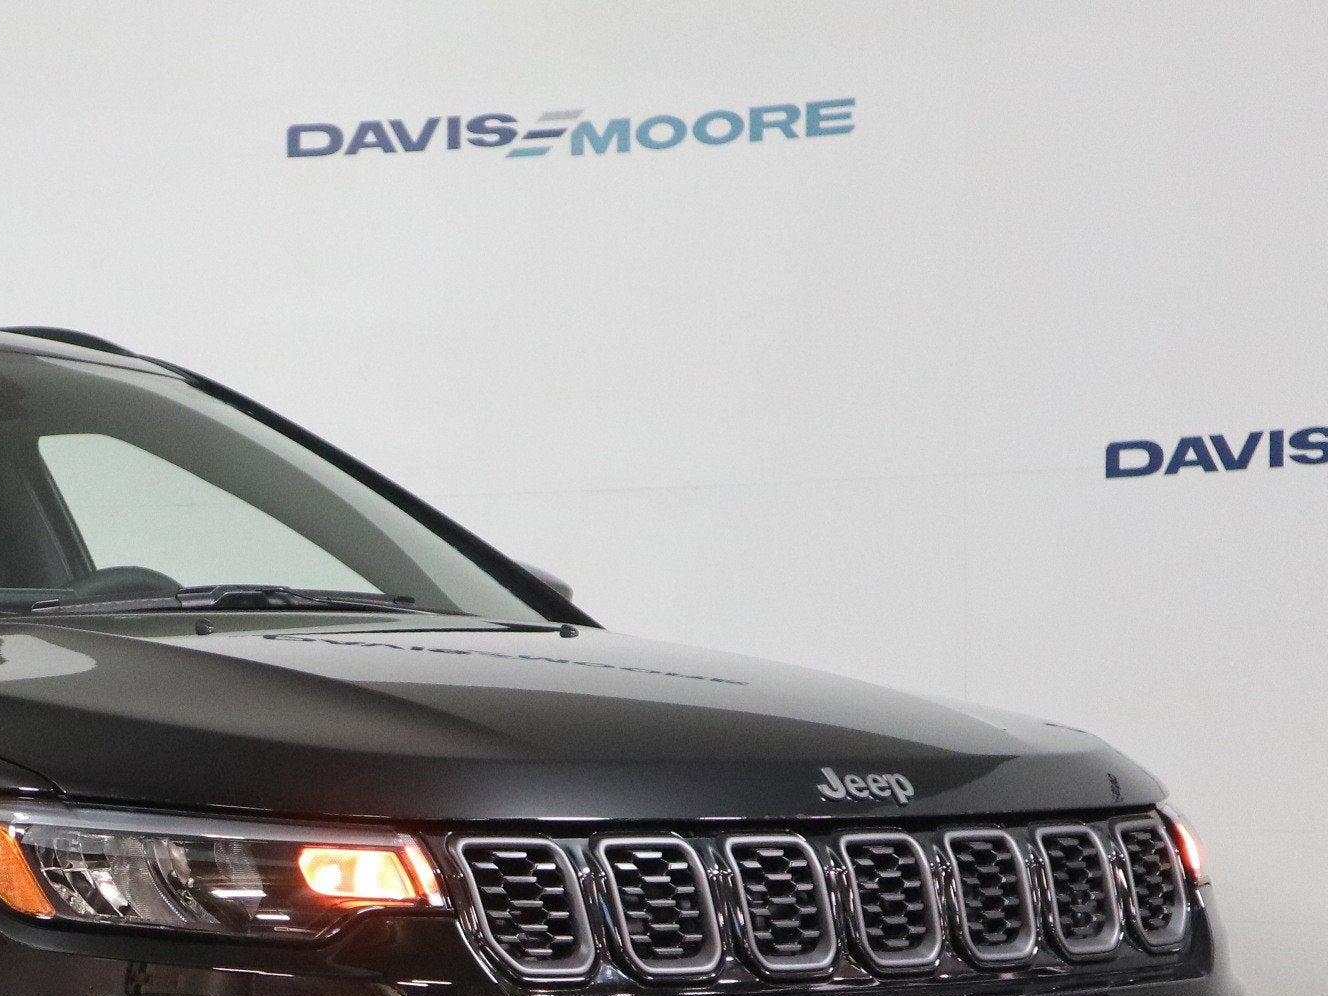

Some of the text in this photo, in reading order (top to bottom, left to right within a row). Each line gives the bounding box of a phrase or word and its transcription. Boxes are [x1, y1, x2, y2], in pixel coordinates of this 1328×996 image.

[285, 97, 856, 158] DAVIS MOORE
[1105, 426, 1328, 479] DAVIS
[817, 766, 915, 808] Jeep
